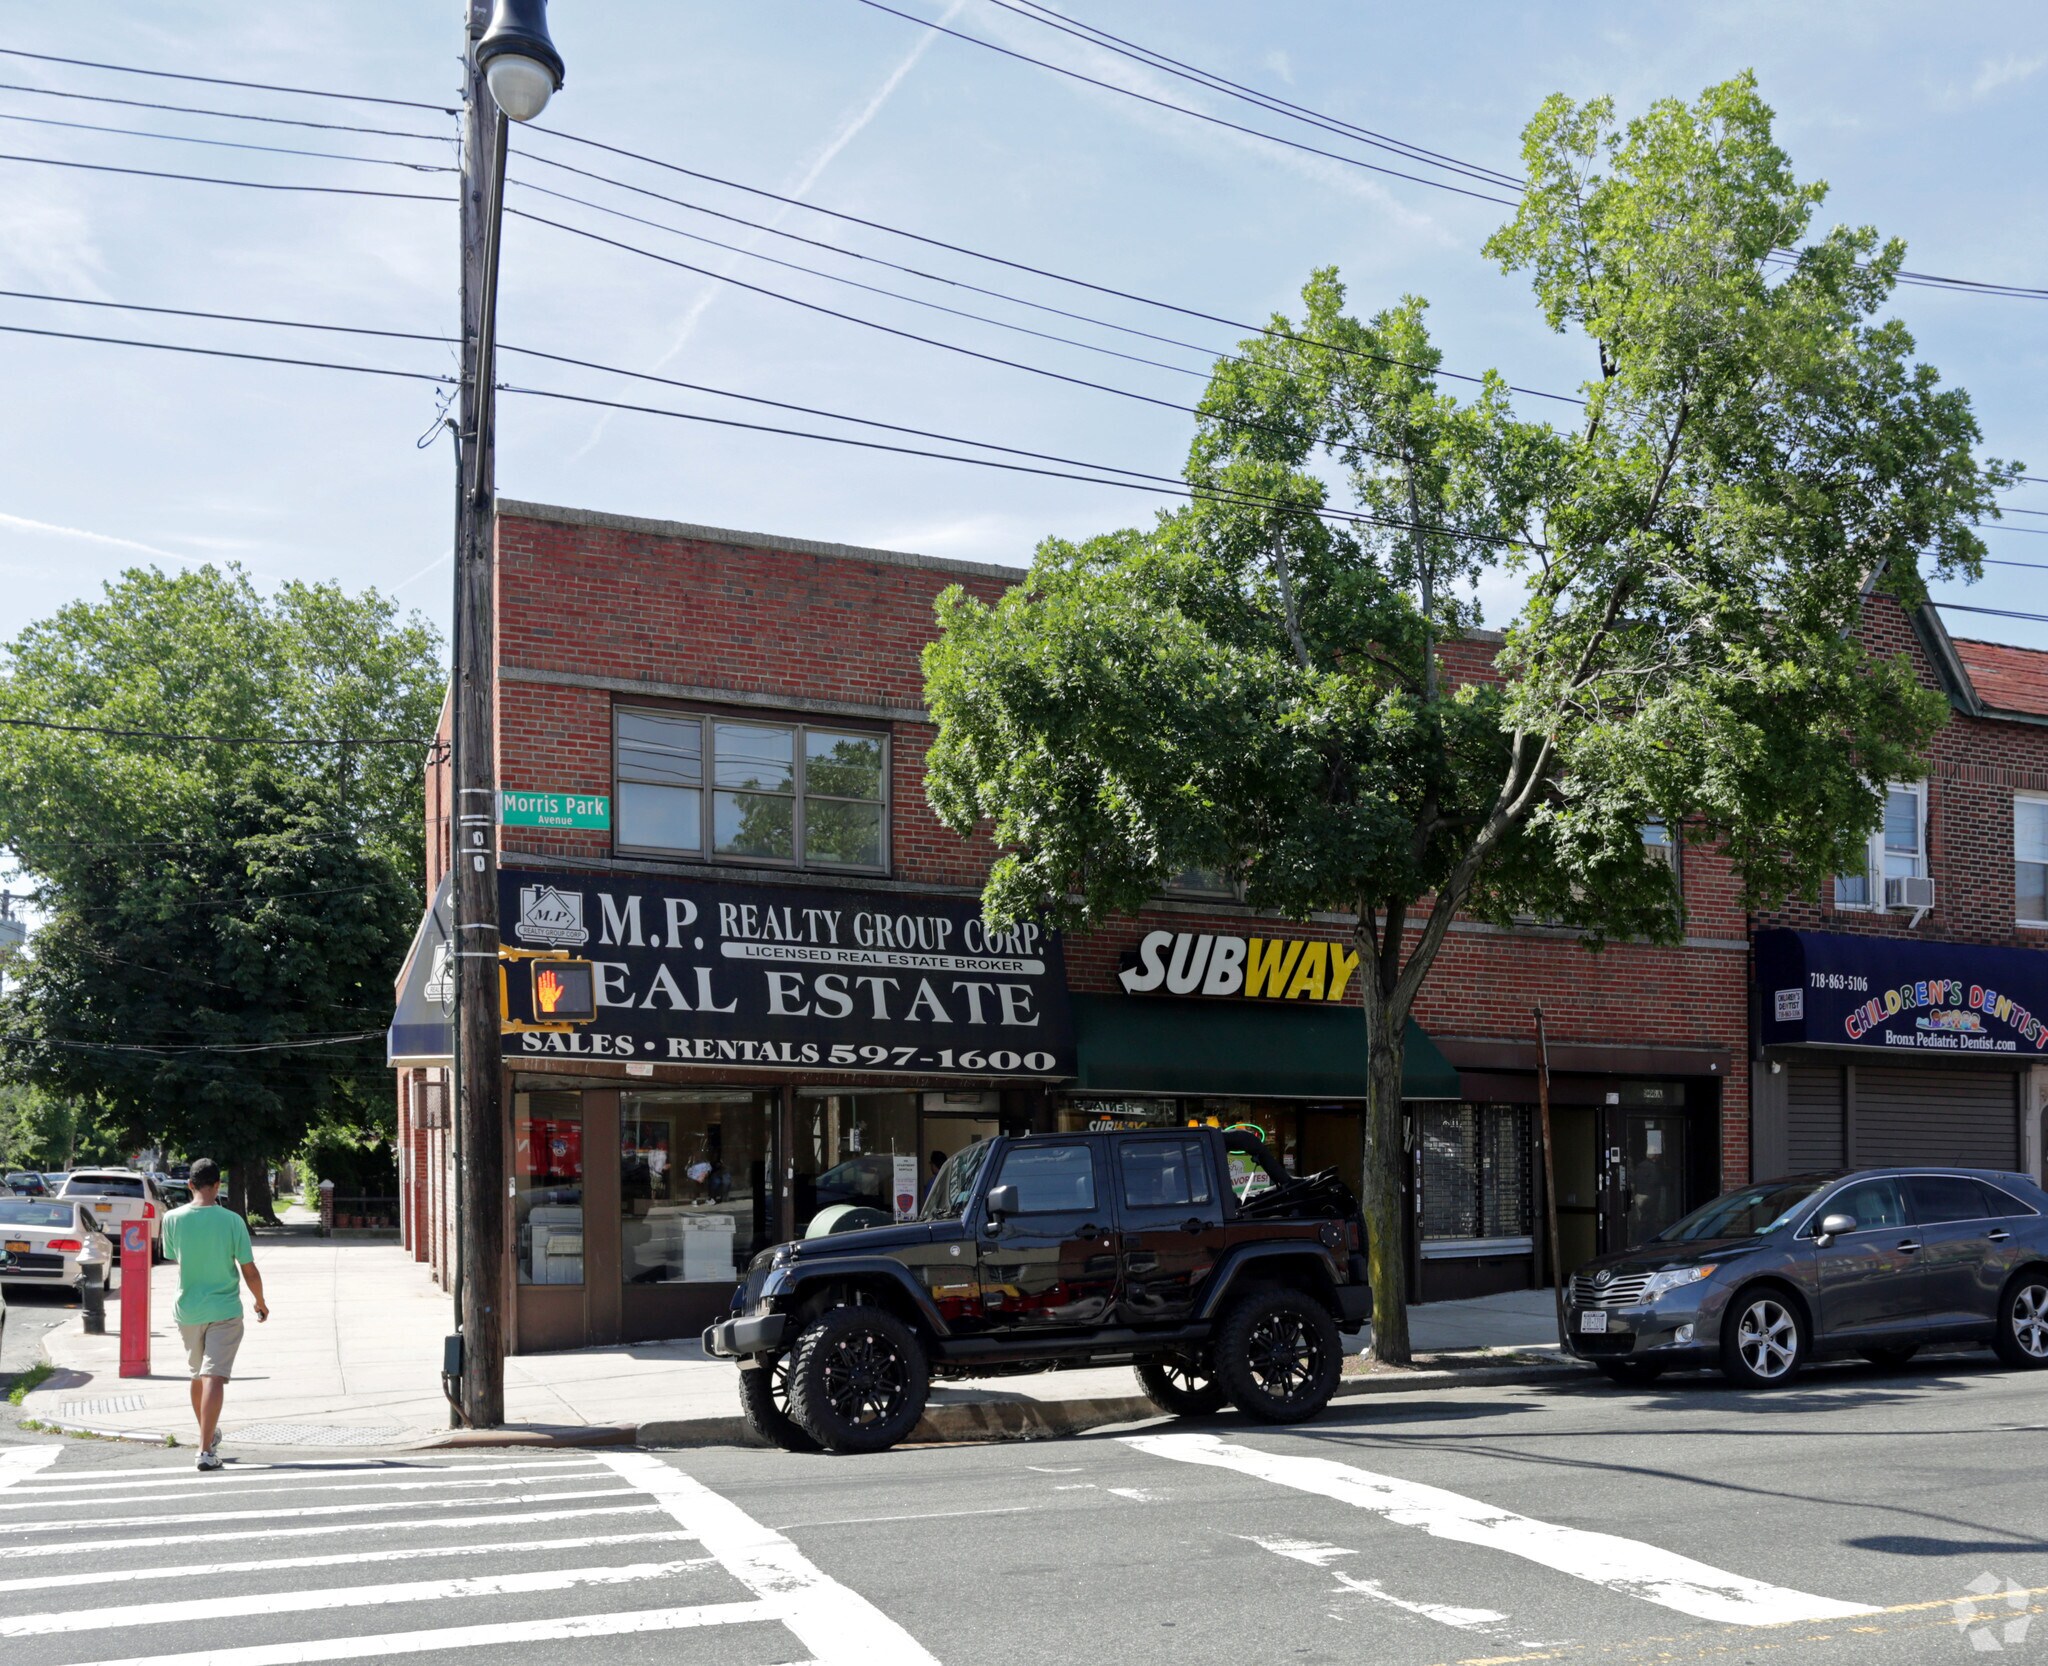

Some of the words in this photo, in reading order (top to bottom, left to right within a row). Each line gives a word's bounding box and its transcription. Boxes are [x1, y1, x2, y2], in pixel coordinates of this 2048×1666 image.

[504, 794, 558, 813] Morris
[566, 797, 604, 816] Park
[538, 815, 573, 825] Avenue
[534, 909, 570, 923] M.P.
[597, 893, 704, 950] M.P.
[718, 902, 842, 945] REALTY
[853, 912, 953, 951] GROUP
[964, 919, 1044, 956] CORP.
[523, 927, 545, 935] REALTY
[545, 928, 565, 936] GROUP
[746, 946, 832, 962] LICENSED
[838, 952, 882, 965] REAL
[888, 954, 950, 968] ESTATE
[955, 958, 1023, 972] BROKER
[1119, 930, 1360, 1001] SUBWAY
[594, 961, 738, 1013] EAL
[764, 970, 1040, 1027] ESTATE
[1845, 979, 1962, 1039] CHILDREN'S
[522, 1031, 635, 1056] SALES
[666, 1037, 820, 1063] RENTALS
[827, 1044, 1057, 1071] 597-1600
[1885, 1030, 1914, 1046] Bronx
[1916, 1032, 1958, 1048] Pediatric
